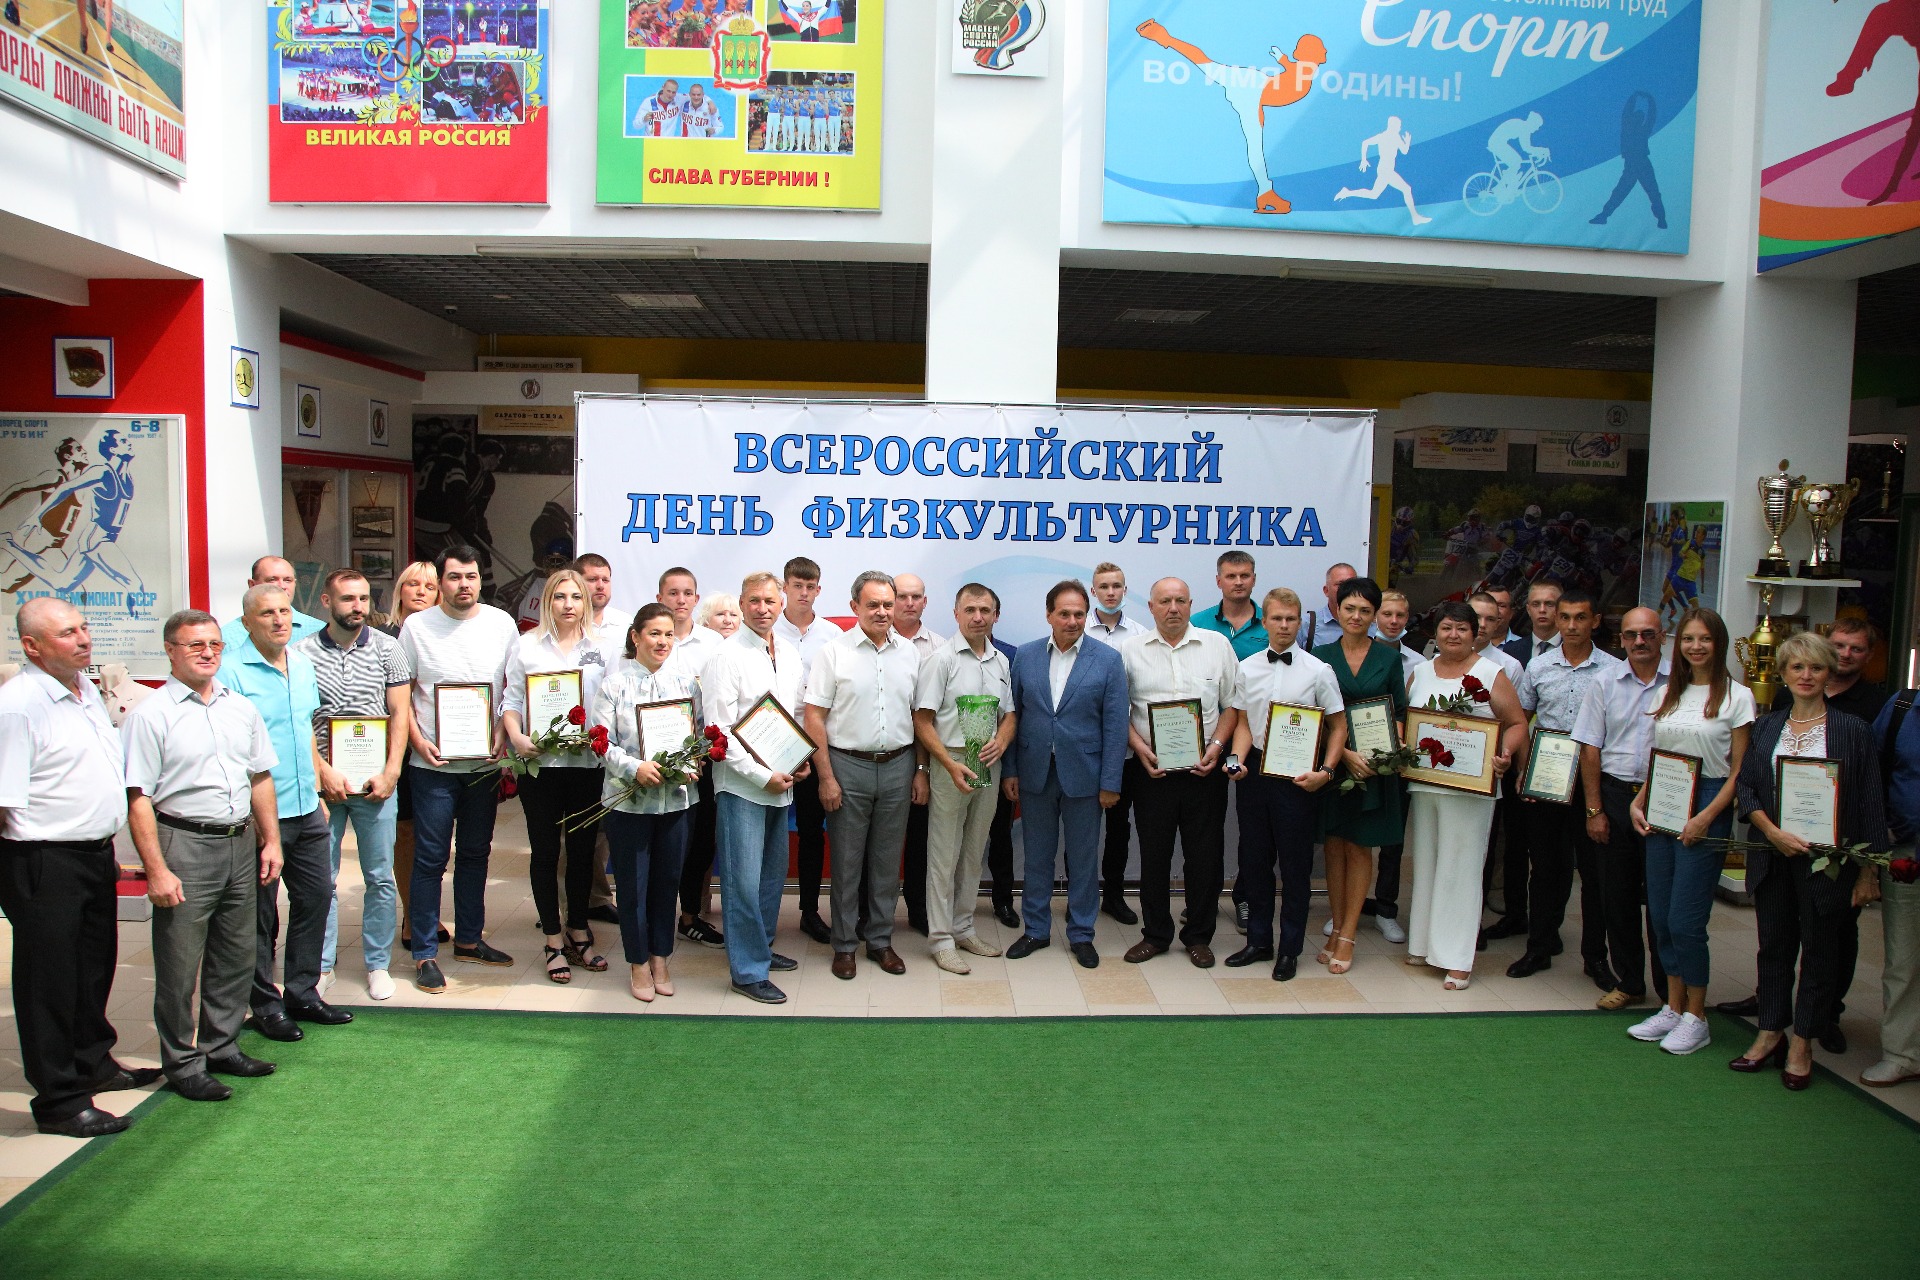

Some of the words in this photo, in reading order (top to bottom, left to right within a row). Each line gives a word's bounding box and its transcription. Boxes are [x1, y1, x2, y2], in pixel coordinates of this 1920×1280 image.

[963, 24, 999, 32] МАСТЕР
[963, 32, 998, 40] СПОРТА
[963, 40, 999, 48] РОССИИ
[1295, 60, 1462, 102] Родины!
[54, 60, 112, 126] ДОЛЖНЫ
[118, 95, 150, 145] БЫТЬ
[306, 129, 412, 146] ВЕЛИКАЯ
[419, 129, 511, 146] РОССИЯ
[649, 168, 713, 185] СЛАВА
[719, 169, 818, 187] ГУБЕРНИИ
[734, 427, 1223, 483] ВСЕРОССИЙСКИЙ
[622, 493, 774, 543] ДЕНЬ
[801, 496, 1328, 547] ФИЗКУЛЬТУРНИКА
